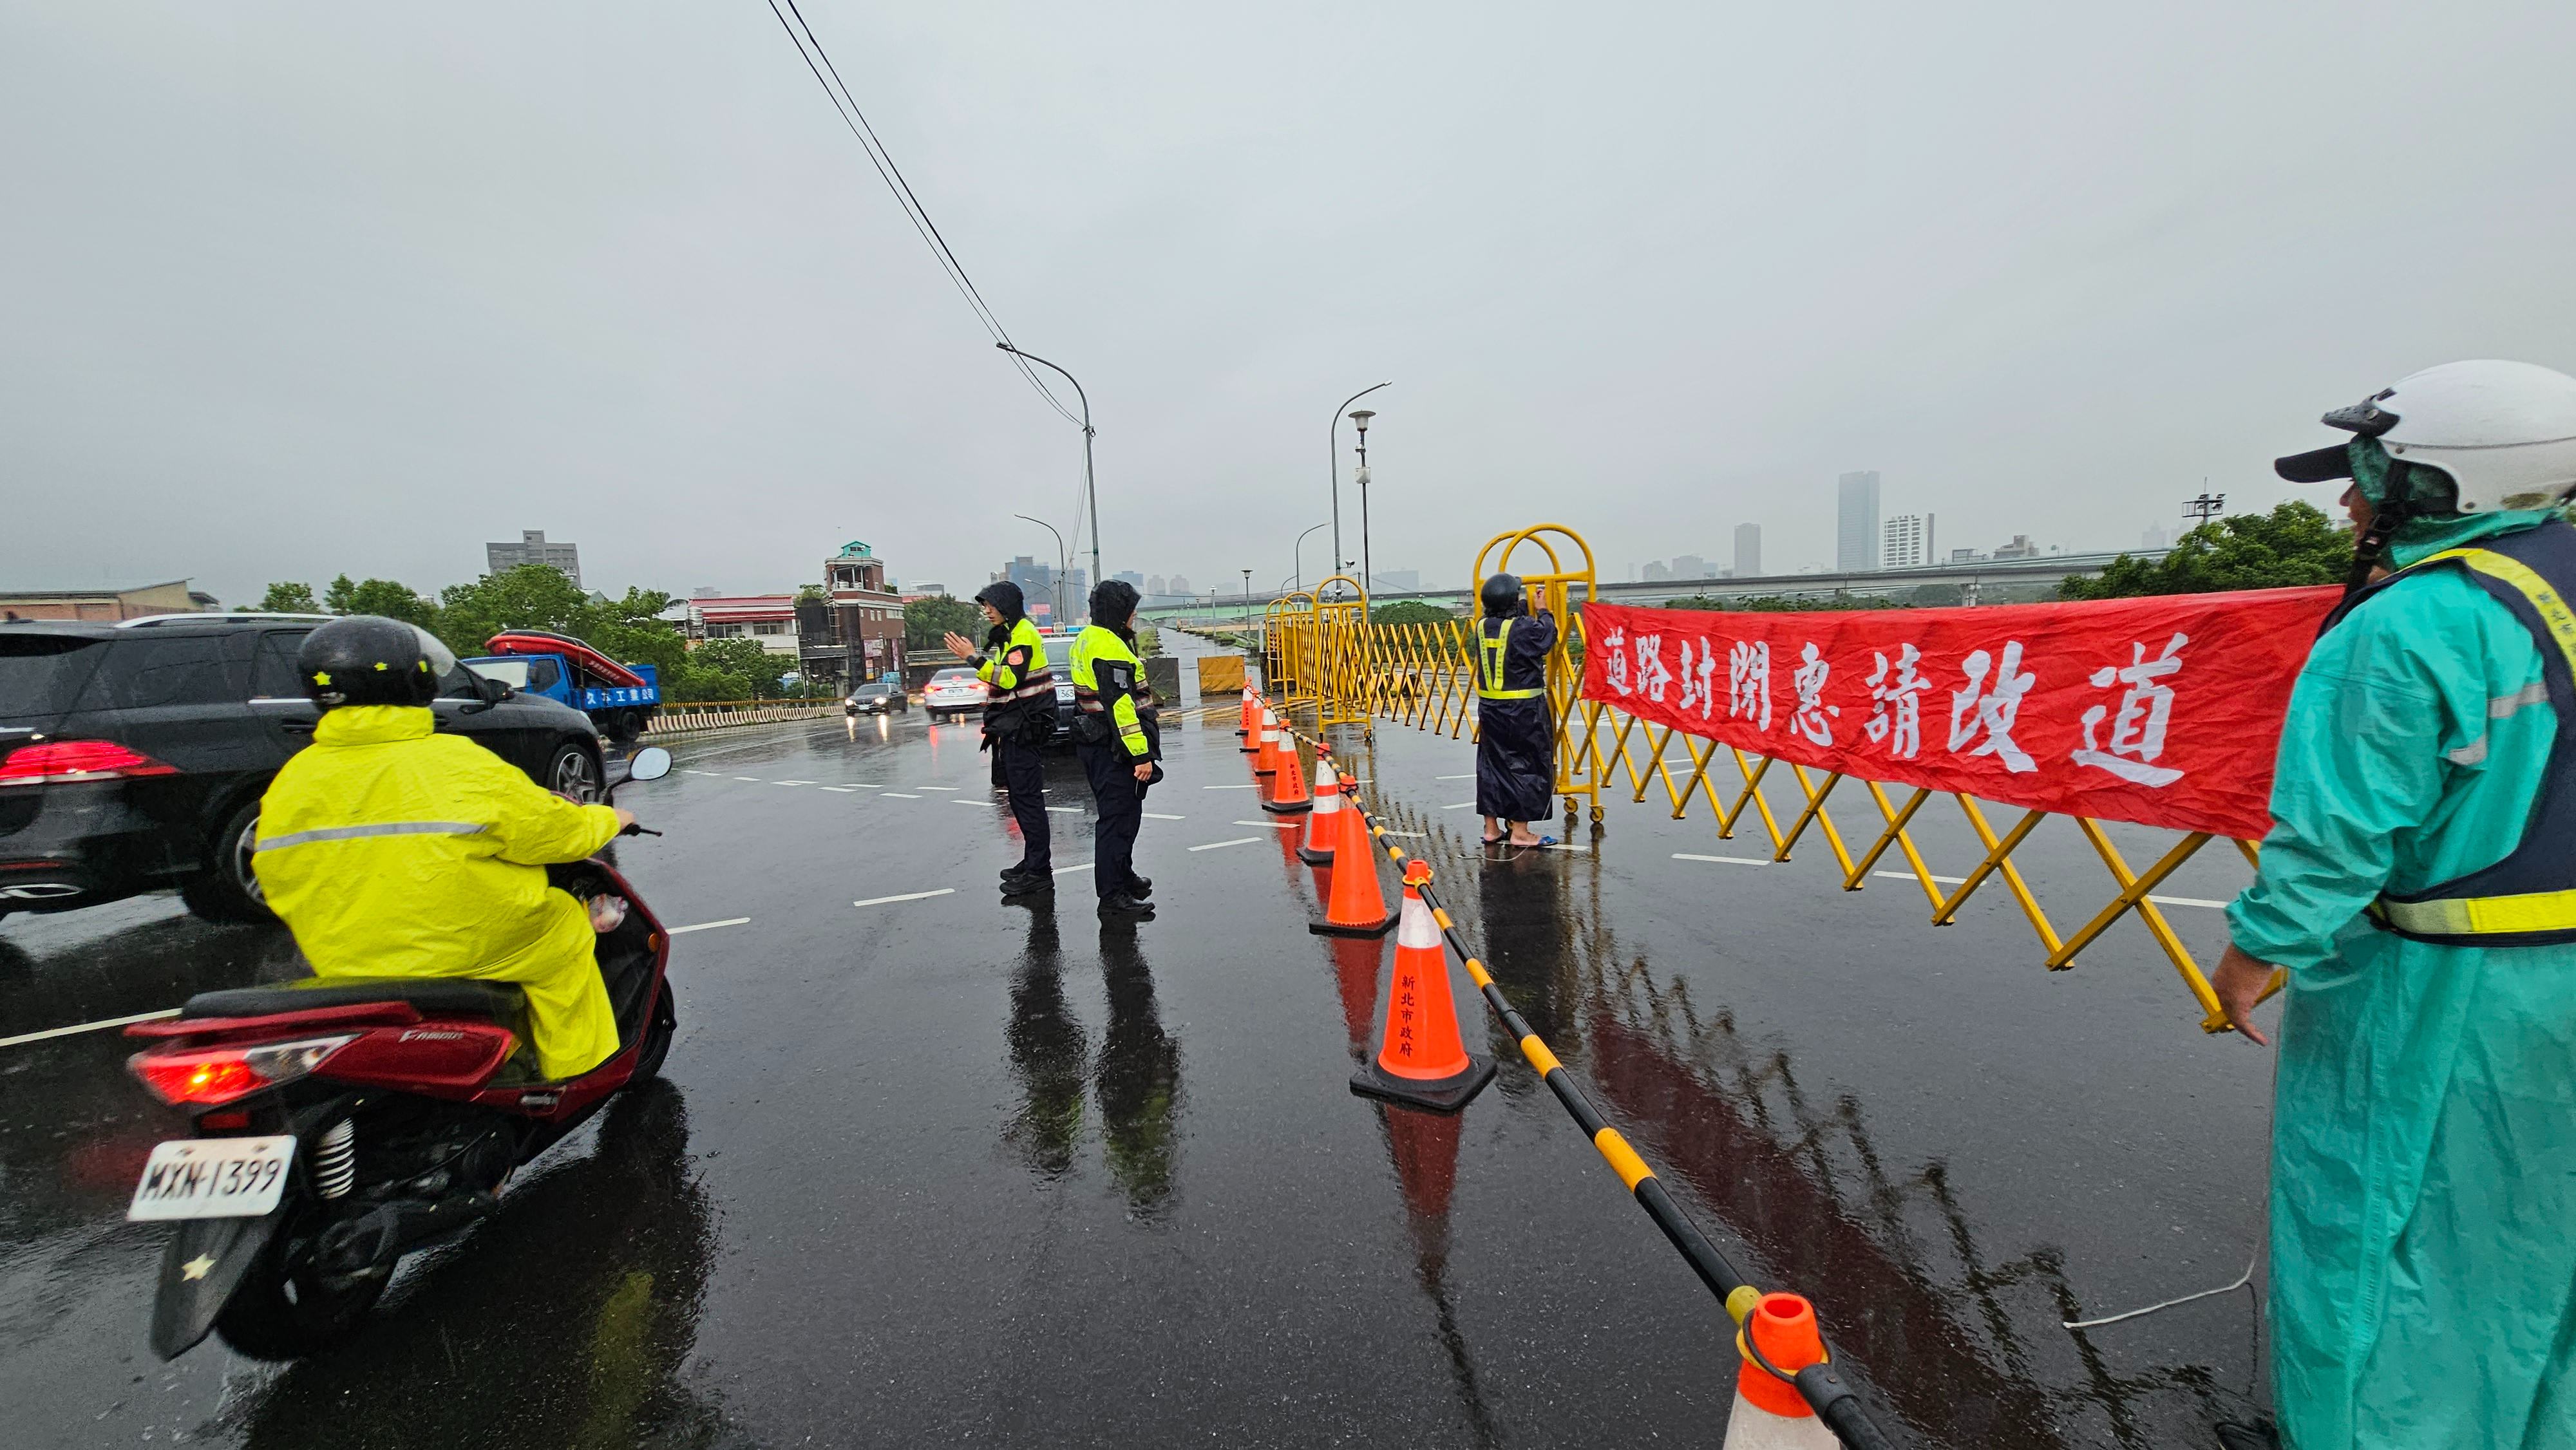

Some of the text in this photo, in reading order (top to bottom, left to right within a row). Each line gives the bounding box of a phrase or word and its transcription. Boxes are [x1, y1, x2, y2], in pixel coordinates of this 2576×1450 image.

[1399, 975, 1416, 1058] 新北市政府
[140, 1158, 281, 1201] MXN-1399
